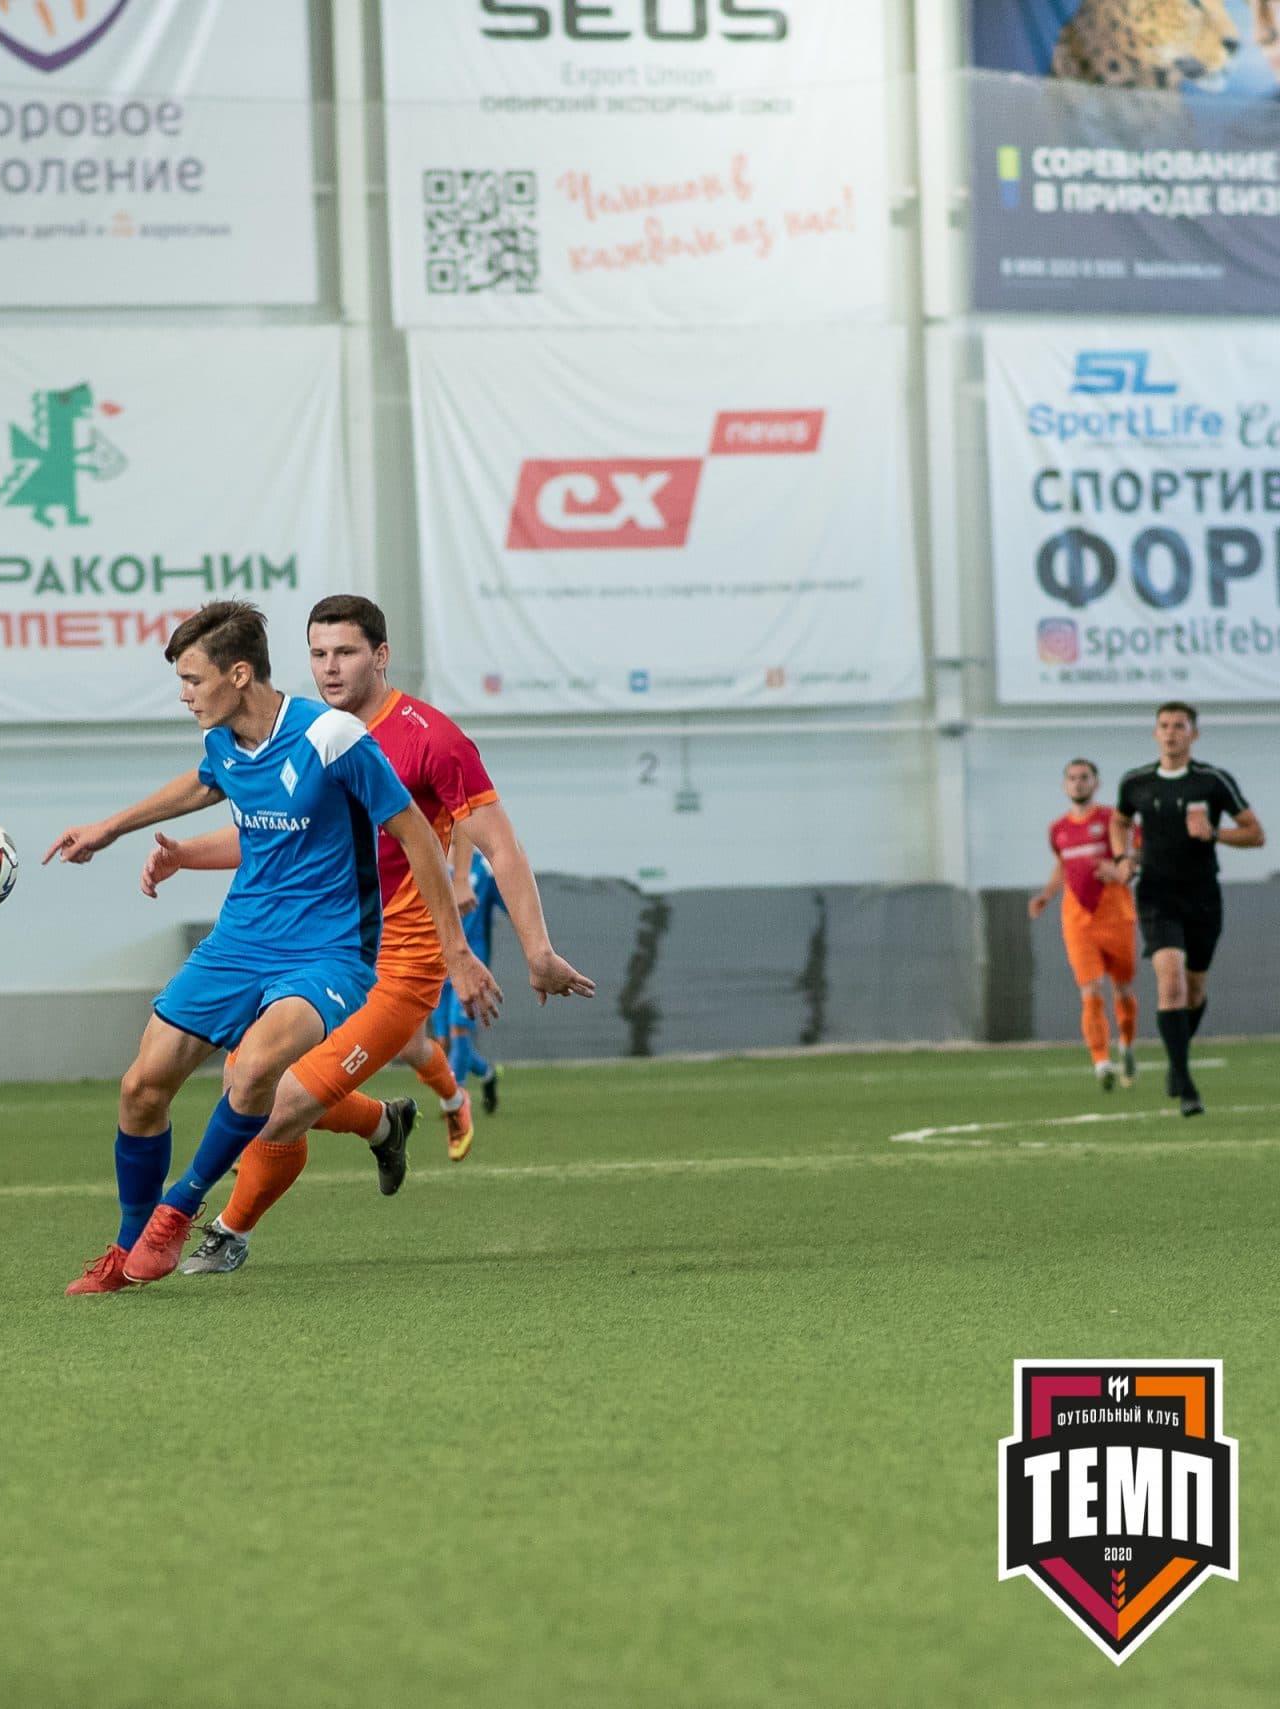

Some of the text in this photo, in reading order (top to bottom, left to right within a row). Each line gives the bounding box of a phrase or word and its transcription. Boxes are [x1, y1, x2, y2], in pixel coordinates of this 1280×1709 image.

[561, 61, 716, 86] Export Union
[1063, 183, 1211, 218] ПРИРОДЕ
[1070, 350, 1178, 394] SL
[725, 419, 809, 445] news
[1028, 404, 1223, 441] SportLife
[1035, 526, 1280, 610] ФОР
[1085, 617, 1280, 662] sportlifeb
[638, 751, 659, 785] 2
[340, 1044, 368, 1075] 13
